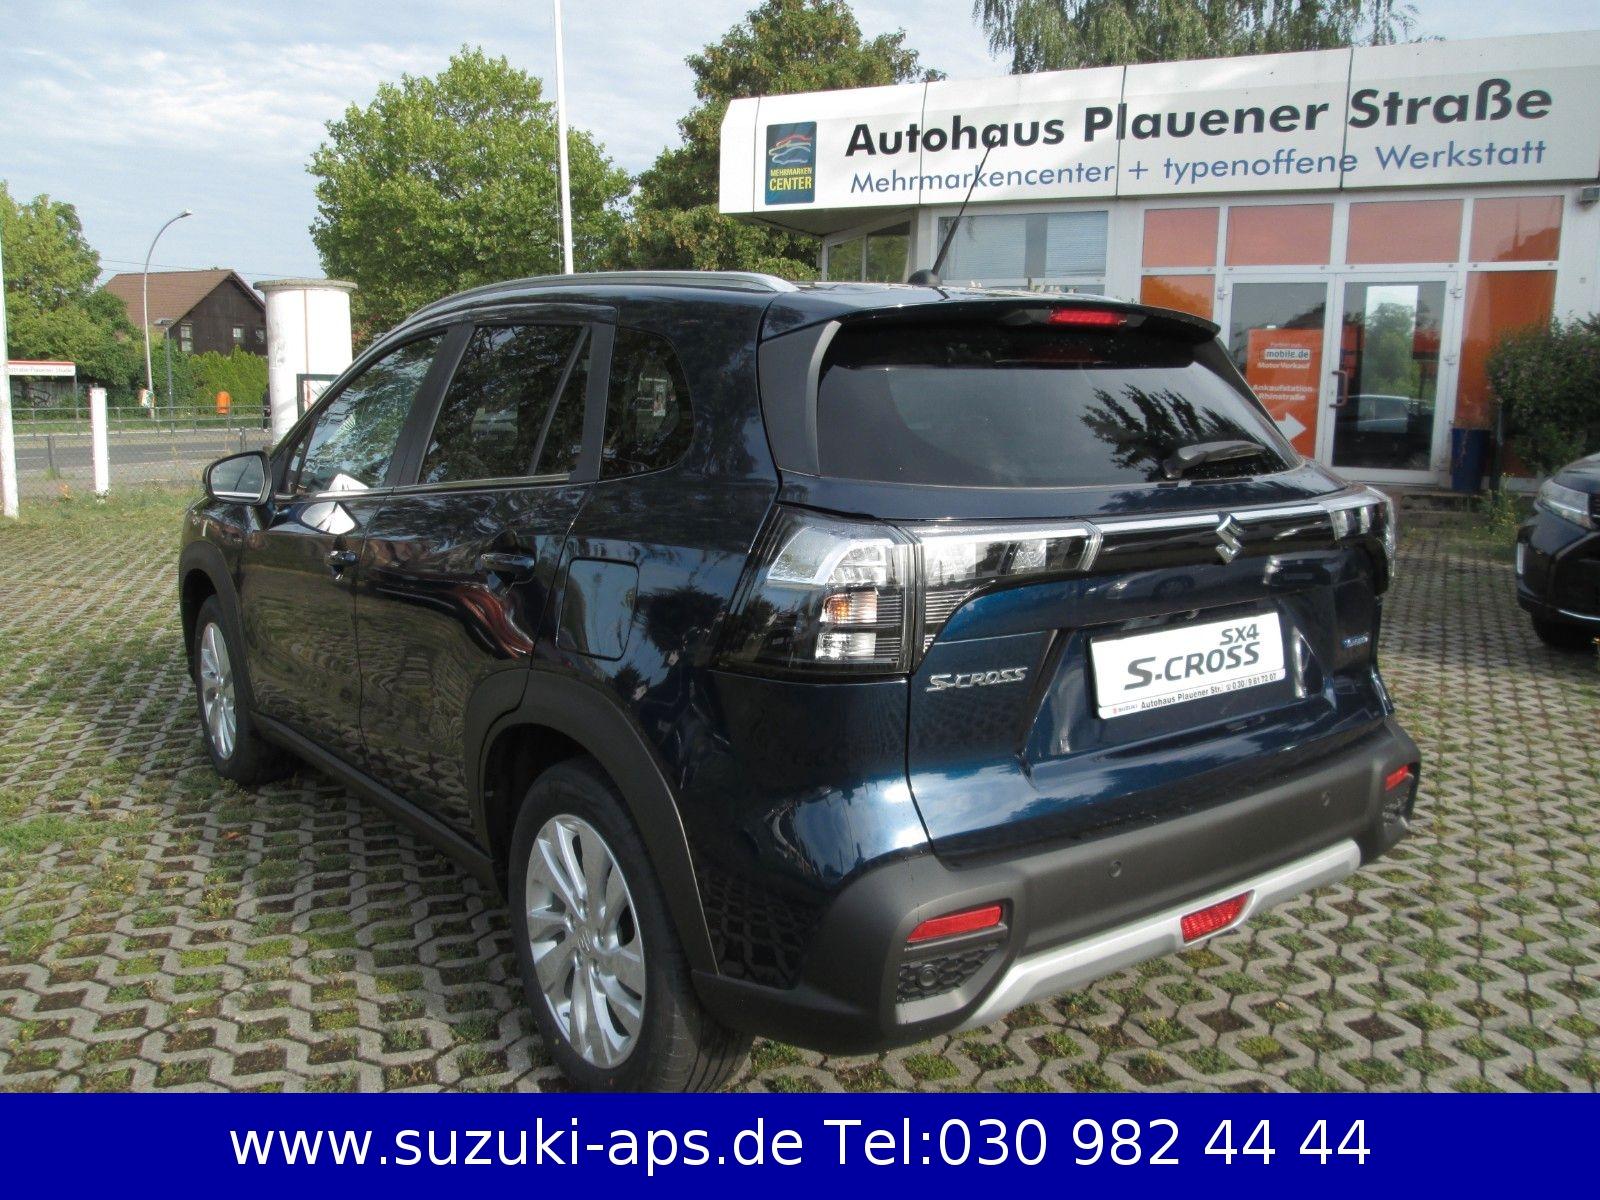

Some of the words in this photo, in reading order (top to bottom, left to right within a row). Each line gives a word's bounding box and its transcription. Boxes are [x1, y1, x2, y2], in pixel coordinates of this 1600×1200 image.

[845, 115, 1065, 157] Autohaus
[1084, 102, 1330, 142] Plauener
[1347, 78, 1553, 129] Straße
[770, 167, 812, 177] MEHRMARKEN
[850, 160, 1116, 194] Mehrmarkencenter
[1164, 149, 1358, 185] typenoffene
[1375, 140, 1547, 170] Werkstatt
[769, 176, 812, 191] CENTER
[1266, 349, 1309, 358] mobile.de
[1220, 623, 1259, 646] SX4
[1124, 641, 1260, 690] S-CROSS
[1141, 696, 1176, 709] Autohaus
[1177, 689, 1209, 700] Plauener
[1210, 685, 1221, 694] Str.
